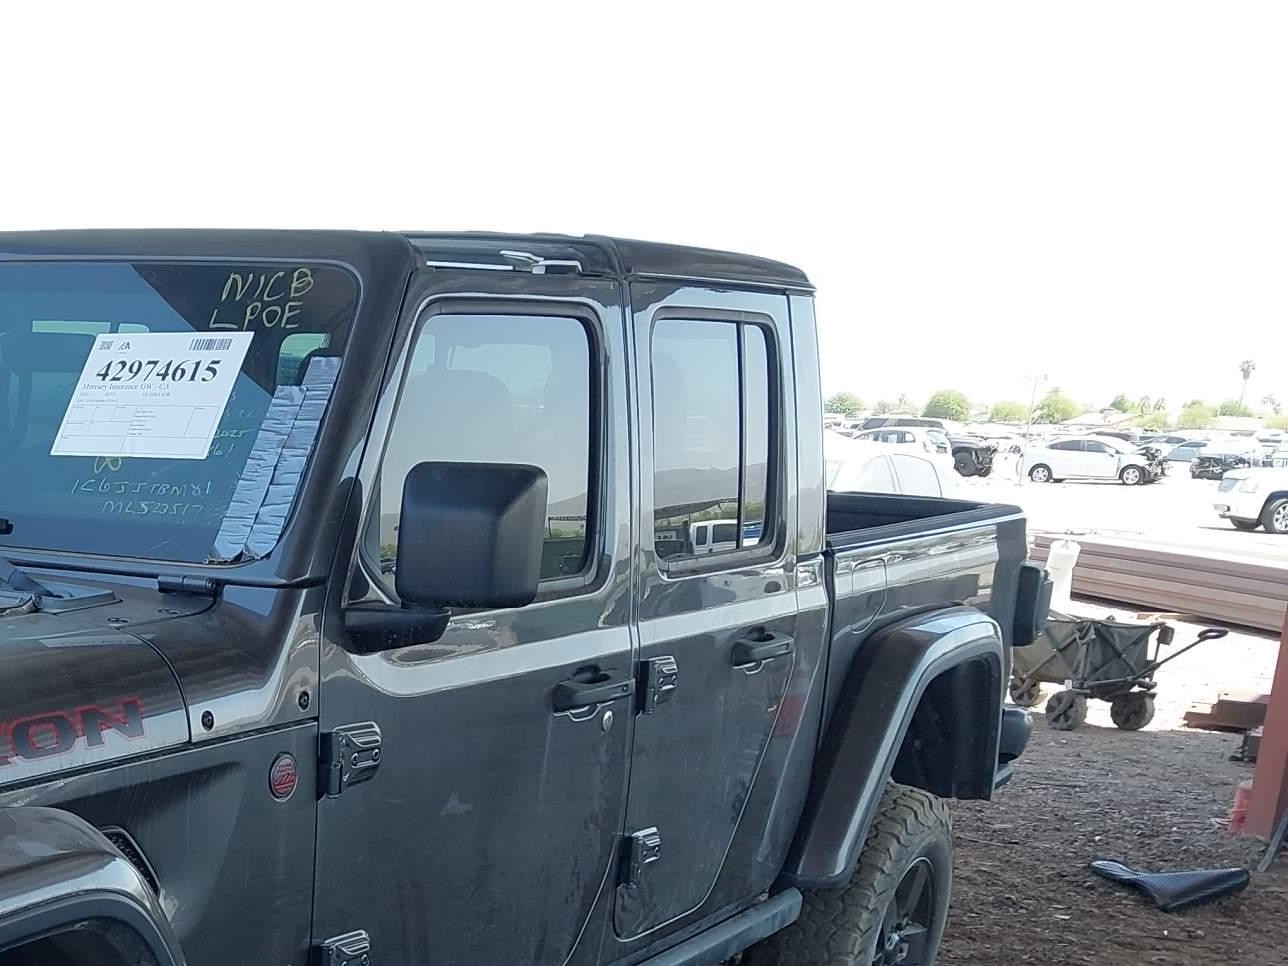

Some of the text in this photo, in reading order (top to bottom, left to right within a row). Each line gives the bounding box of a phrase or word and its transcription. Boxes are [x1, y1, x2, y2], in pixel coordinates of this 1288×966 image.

[220, 267, 315, 302] NICB
[95, 359, 223, 382] 42974615
[81, 383, 108, 392] Mercury
